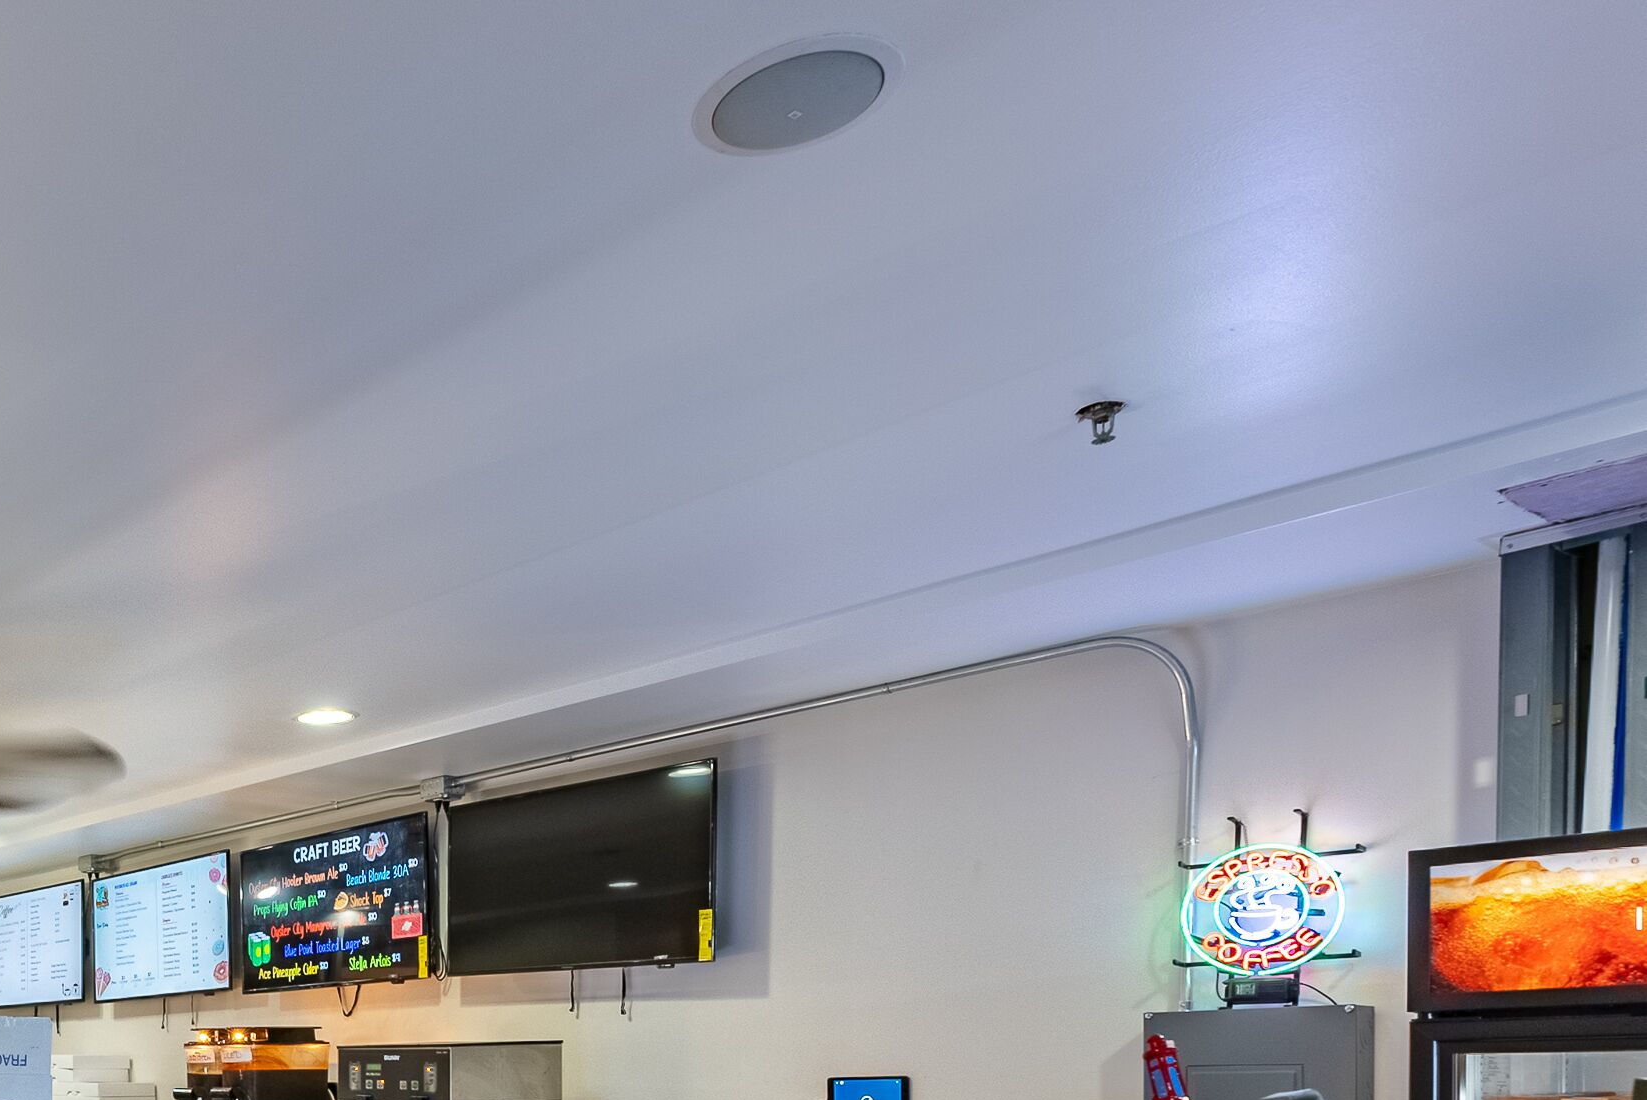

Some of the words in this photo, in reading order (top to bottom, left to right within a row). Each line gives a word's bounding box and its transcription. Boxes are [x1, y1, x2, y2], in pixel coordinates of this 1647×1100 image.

[293, 842, 329, 863] CRAFT
[332, 835, 361, 856] BEER
[282, 873, 303, 889] Hooter
[304, 870, 326, 884] Brown
[327, 866, 338, 880] Ale
[346, 870, 366, 887] Beach
[368, 866, 390, 883] Blonde
[1195, 850, 1337, 902] ESPRESSO
[253, 903, 271, 919] Props
[271, 900, 289, 916] Flying
[289, 896, 306, 912] Coffin
[349, 895, 370, 910] Shock
[371, 892, 384, 909] Top
[270, 925, 290, 942] Oyster
[284, 944, 297, 958] Blue
[298, 942, 313, 956] Point
[315, 939, 339, 953] Toasted
[340, 936, 361, 953] Lager
[1201, 927, 1324, 971] COFFEE
[258, 967, 271, 980] Ace
[272, 964, 301, 982] Pineapple
[302, 961, 319, 976] Cider
[348, 954, 368, 972] Stella
[369, 952, 391, 968] Artois
